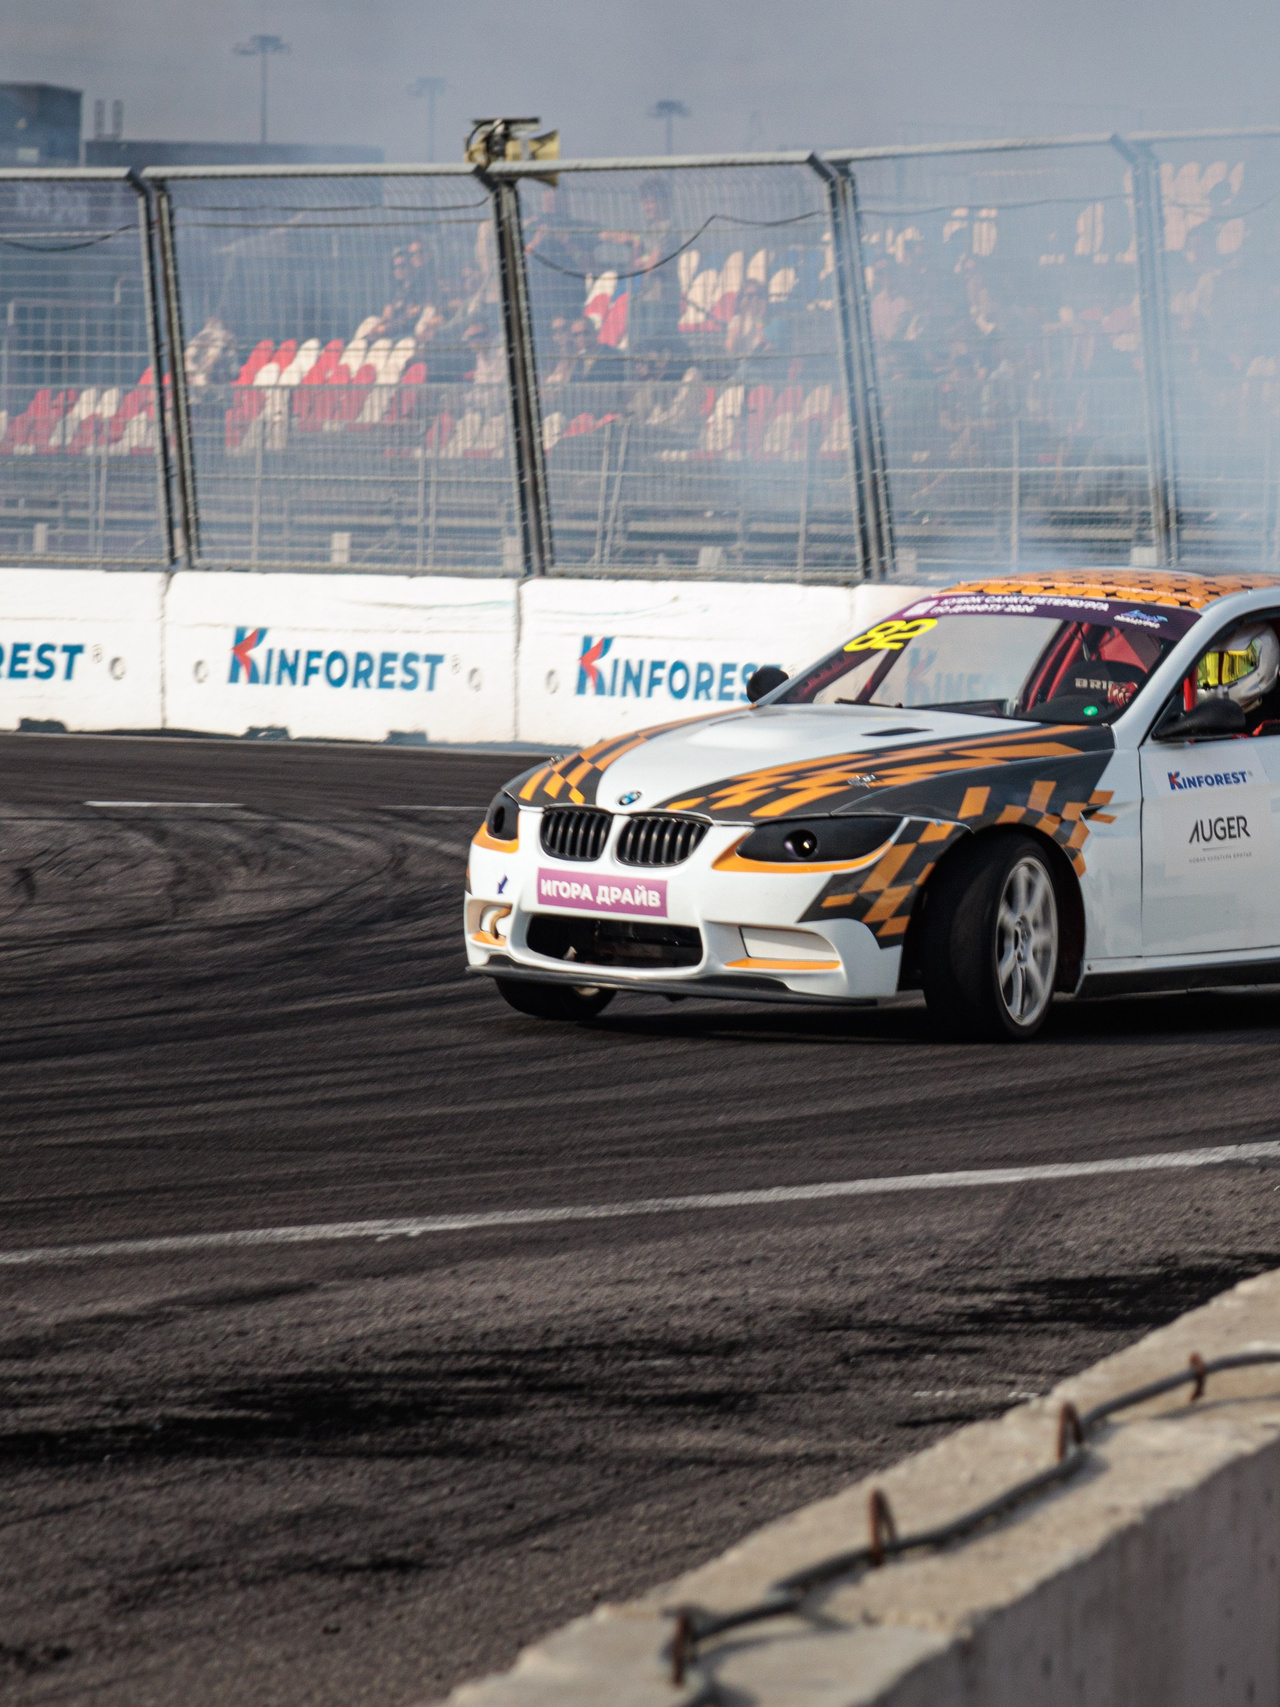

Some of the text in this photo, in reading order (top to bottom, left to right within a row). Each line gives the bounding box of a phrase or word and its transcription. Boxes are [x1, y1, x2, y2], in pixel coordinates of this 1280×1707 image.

[843, 618, 938, 652] 82
[0, 642, 85, 681] EST
[228, 626, 445, 692] KINFOREST
[575, 635, 783, 702] KINFORES
[1167, 771, 1248, 790] KINFOREST
[1189, 815, 1251, 843] AUGER
[541, 879, 661, 907] ИГОРА ДРАЙВ
